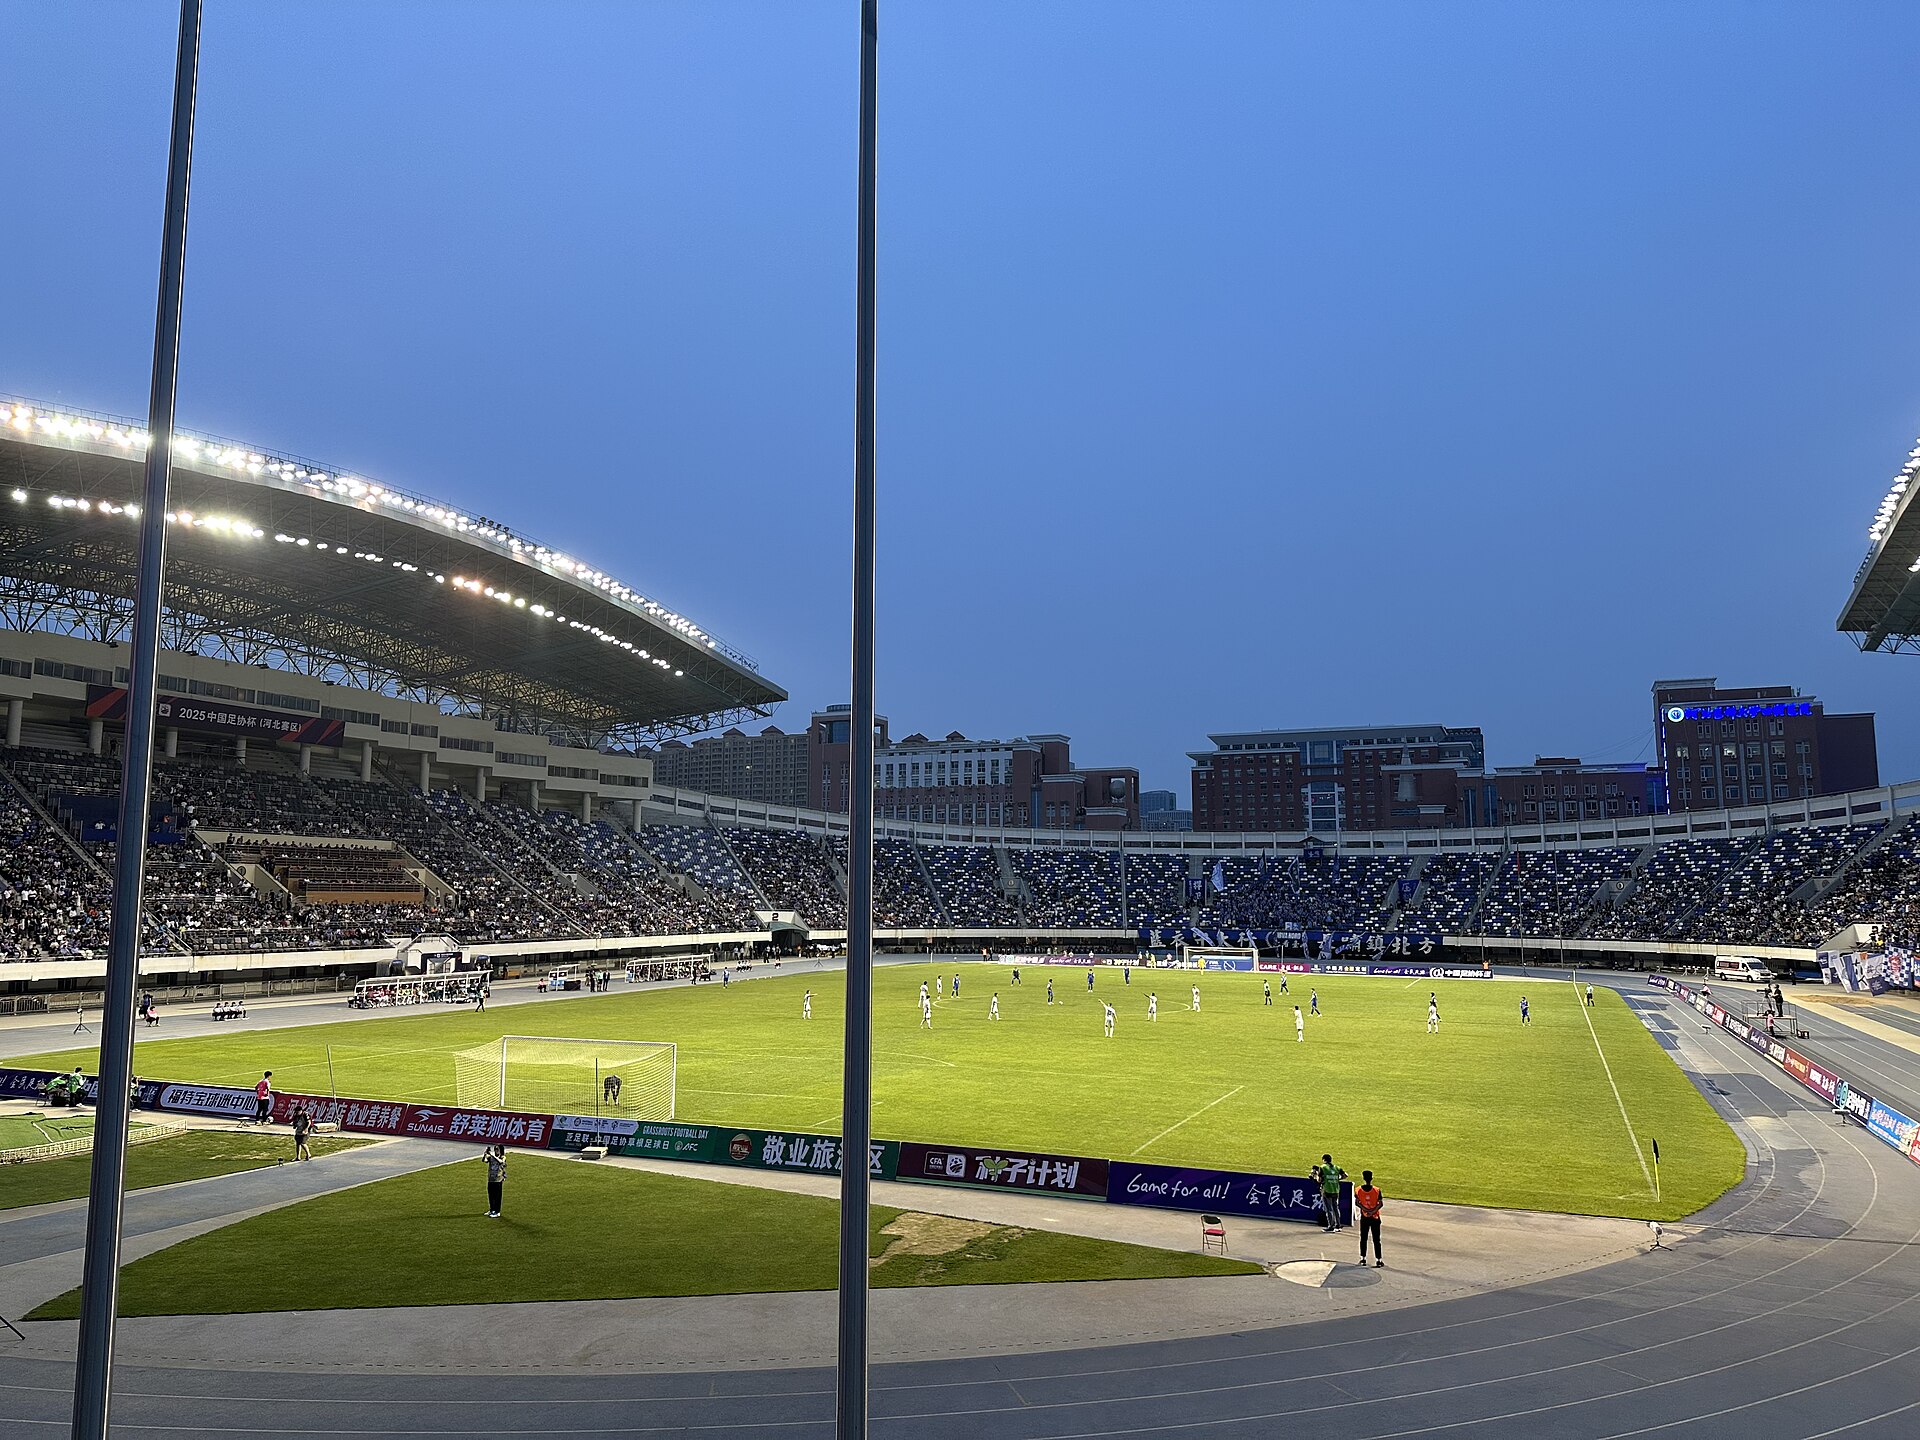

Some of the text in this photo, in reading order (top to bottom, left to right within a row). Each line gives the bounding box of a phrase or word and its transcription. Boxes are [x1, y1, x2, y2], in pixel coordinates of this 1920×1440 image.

[772, 913, 779, 921] 2
[167, 1089, 256, 1111] 福特宝球迷中心
[407, 1122, 444, 1133] SUNAIS
[448, 1112, 547, 1142] 舒莱狮体育
[642, 1125, 709, 1139] GRASSROOTS FOOTBALL DAY
[762, 1135, 885, 1174] 敬业旅区
[930, 1157, 942, 1165] CFA
[975, 1156, 1080, 1188] 种子计划
[1127, 1173, 1230, 1199] Game for all!
